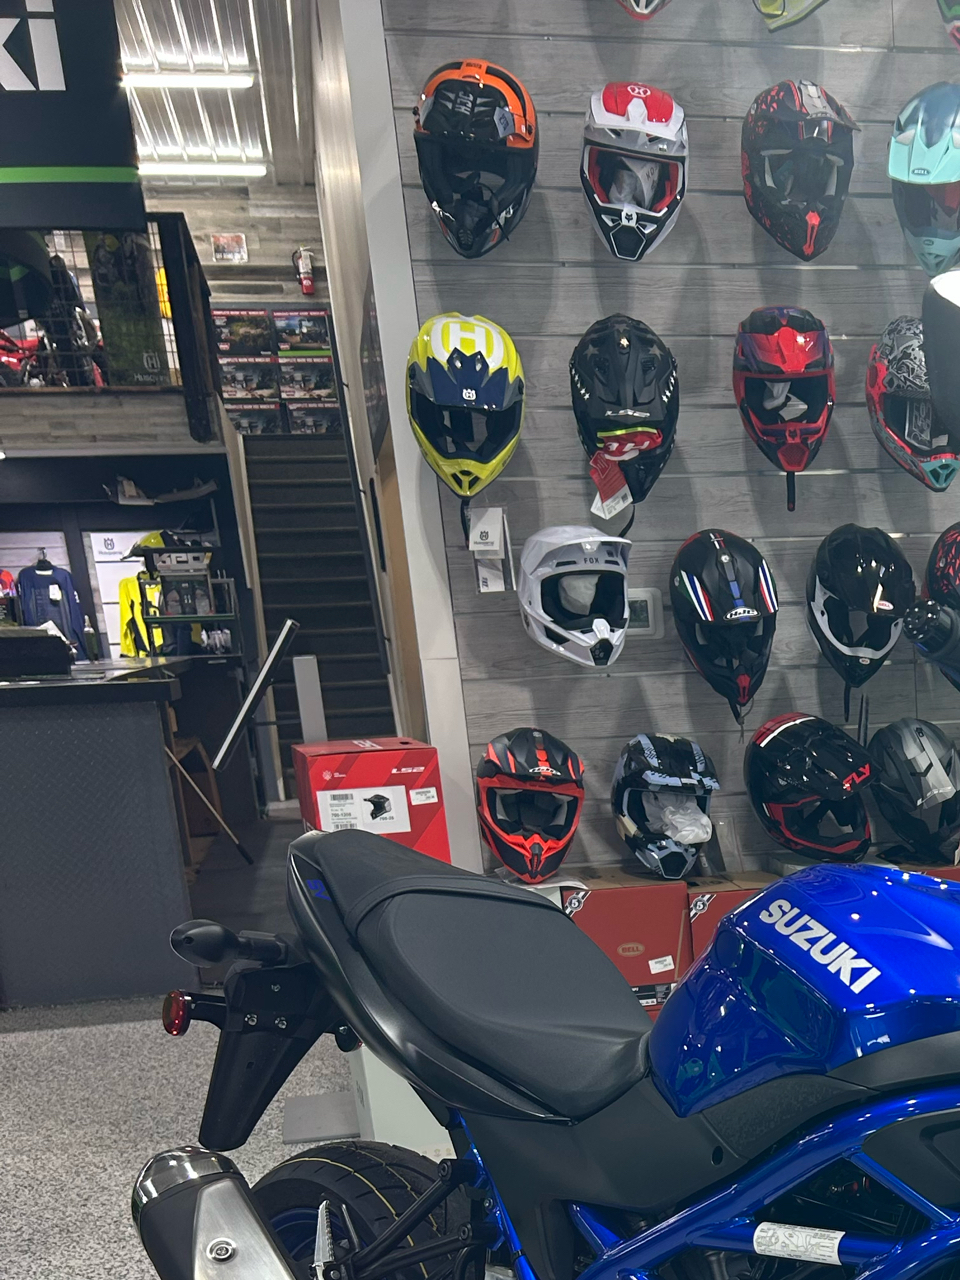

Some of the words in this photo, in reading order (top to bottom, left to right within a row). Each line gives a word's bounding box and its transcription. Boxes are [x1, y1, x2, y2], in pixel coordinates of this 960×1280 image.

[583, 557, 600, 565] FOX
[391, 766, 425, 774] LS2
[842, 763, 871, 792] FLY
[571, 898, 579, 907] 5
[621, 945, 642, 954] BELL
[758, 899, 882, 995] SUZUKI
